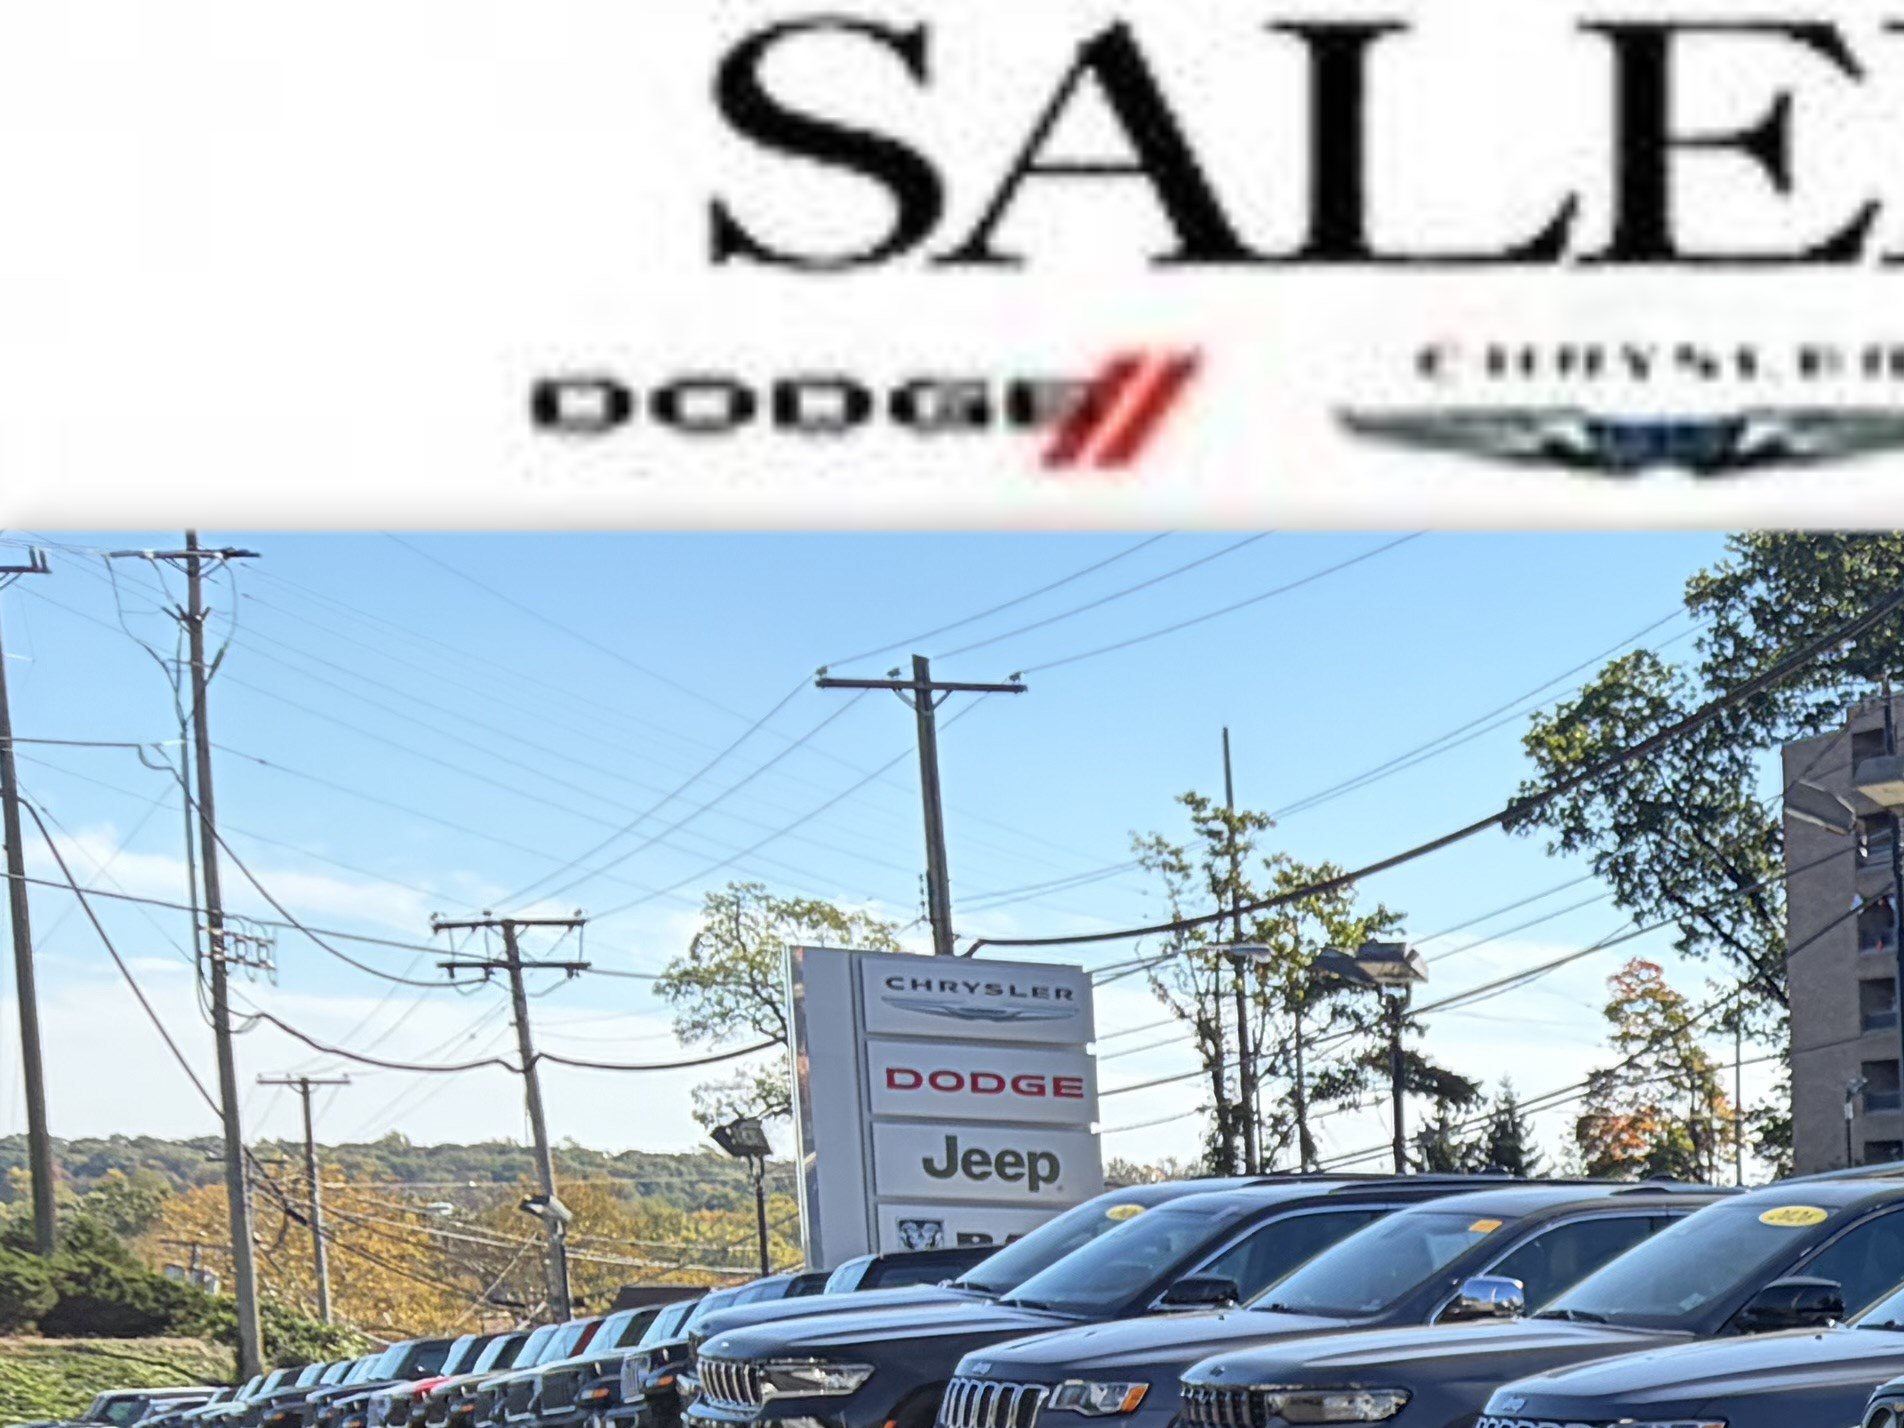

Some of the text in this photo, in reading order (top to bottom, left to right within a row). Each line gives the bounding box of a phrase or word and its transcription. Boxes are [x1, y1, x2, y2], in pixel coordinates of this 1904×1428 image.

[885, 975, 1074, 1001] CHRYSLER
[885, 1066, 1085, 1099] DODGE
[922, 1134, 1061, 1193] Jeep
